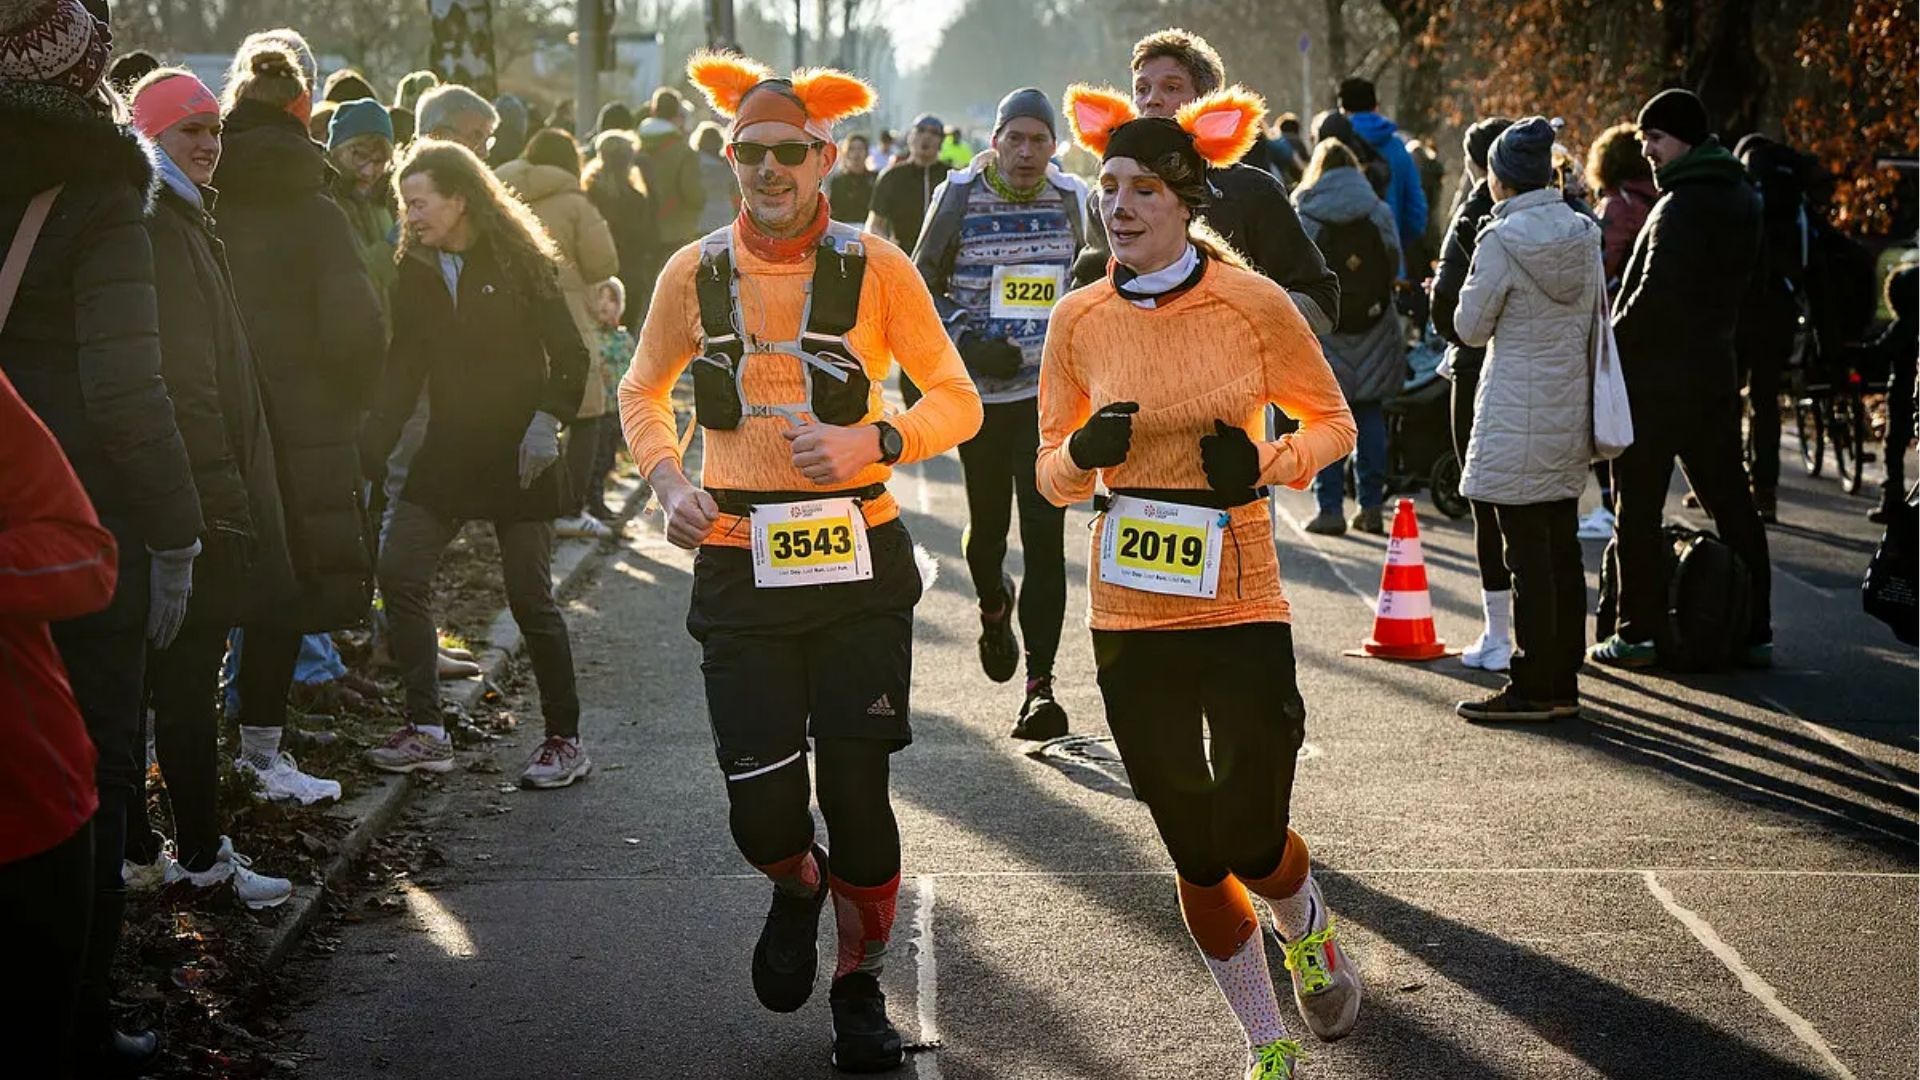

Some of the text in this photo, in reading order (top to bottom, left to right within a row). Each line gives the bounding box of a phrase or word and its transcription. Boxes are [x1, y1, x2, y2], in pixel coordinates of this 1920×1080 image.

[1005, 282, 1055, 301] 3220
[772, 525, 852, 559] 3543
[1120, 527, 1203, 567] 2019
